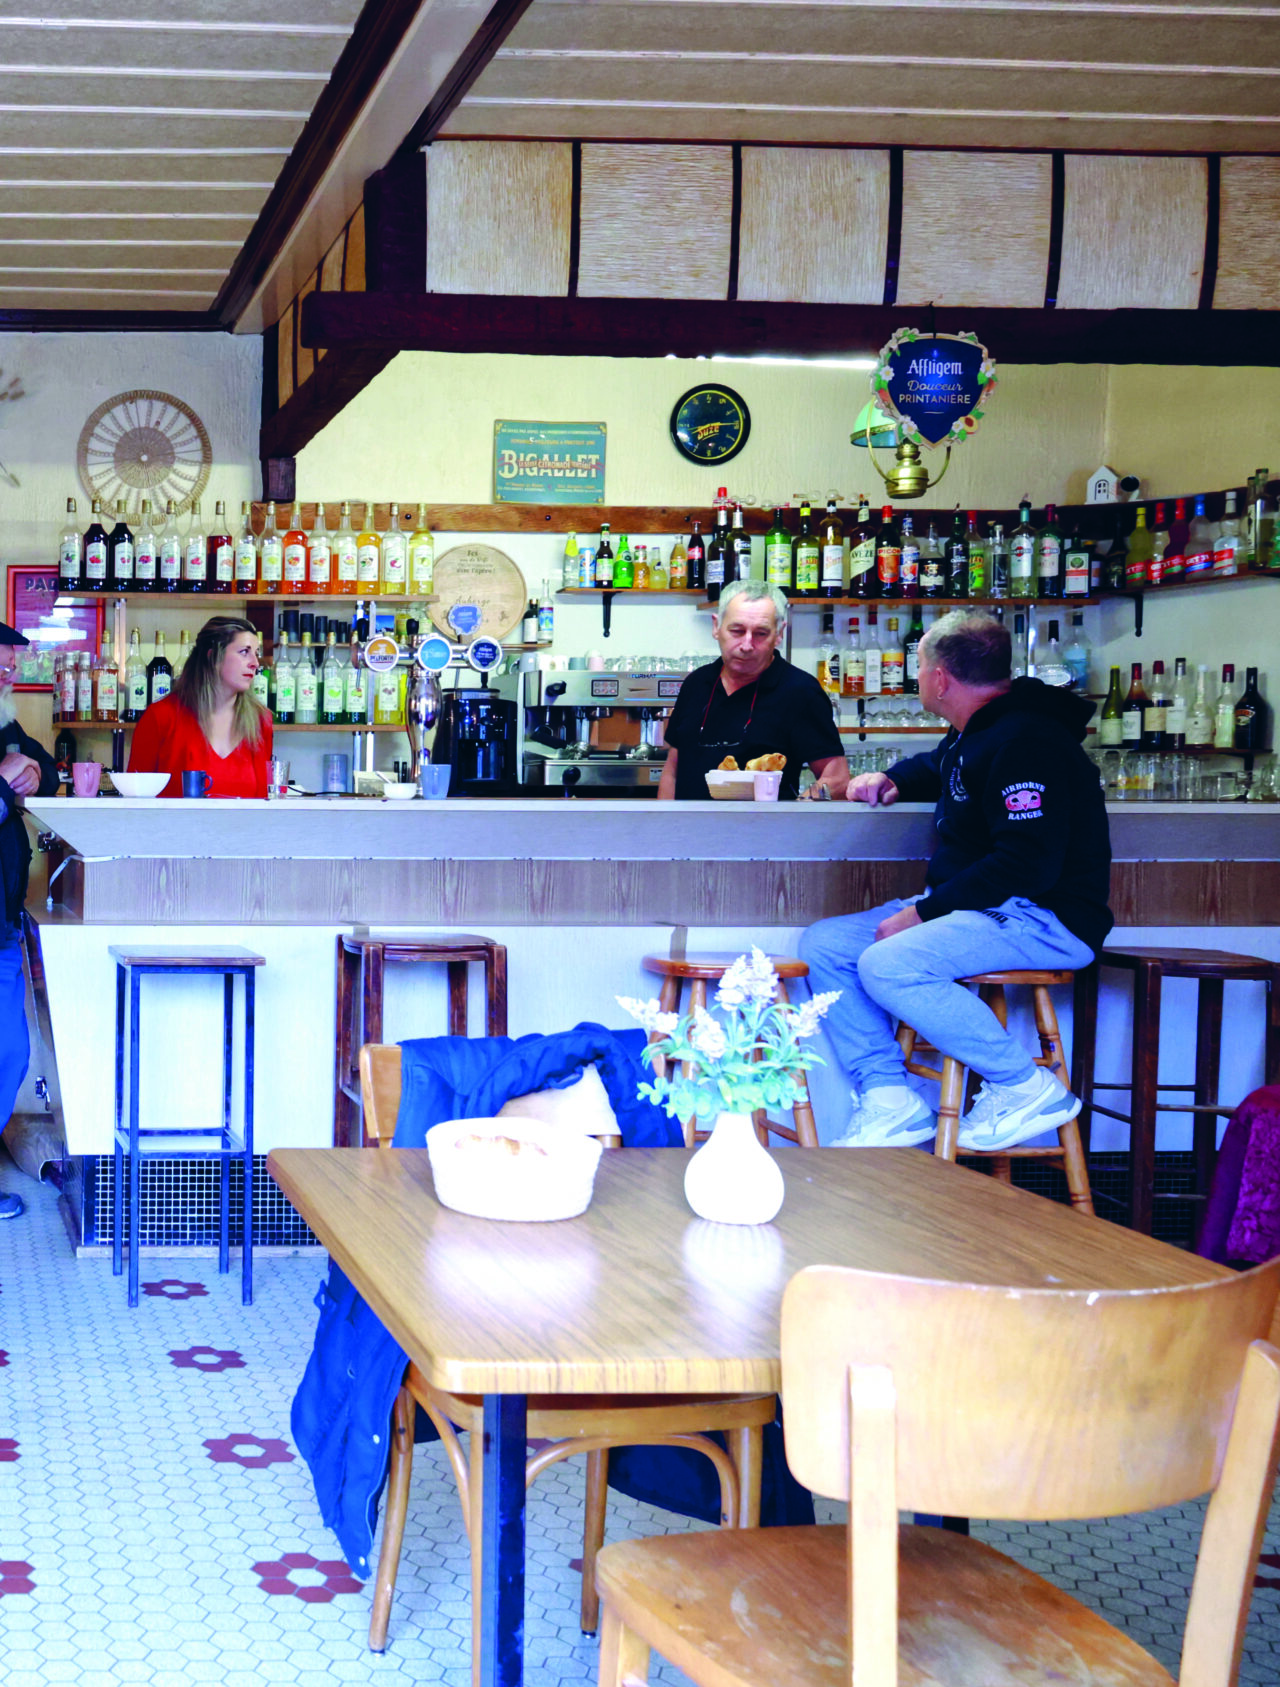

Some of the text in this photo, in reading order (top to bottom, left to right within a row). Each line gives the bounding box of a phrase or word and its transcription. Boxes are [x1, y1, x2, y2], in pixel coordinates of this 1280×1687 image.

[907, 358, 964, 378] Affligem
[907, 379, 963, 392] Douceur
[899, 393, 971, 404] PRINTANIÈRE
[498, 449, 600, 479] BIGALLET
[1001, 781, 1046, 797] AIRBORNE
[1007, 810, 1044, 820] RANGER
